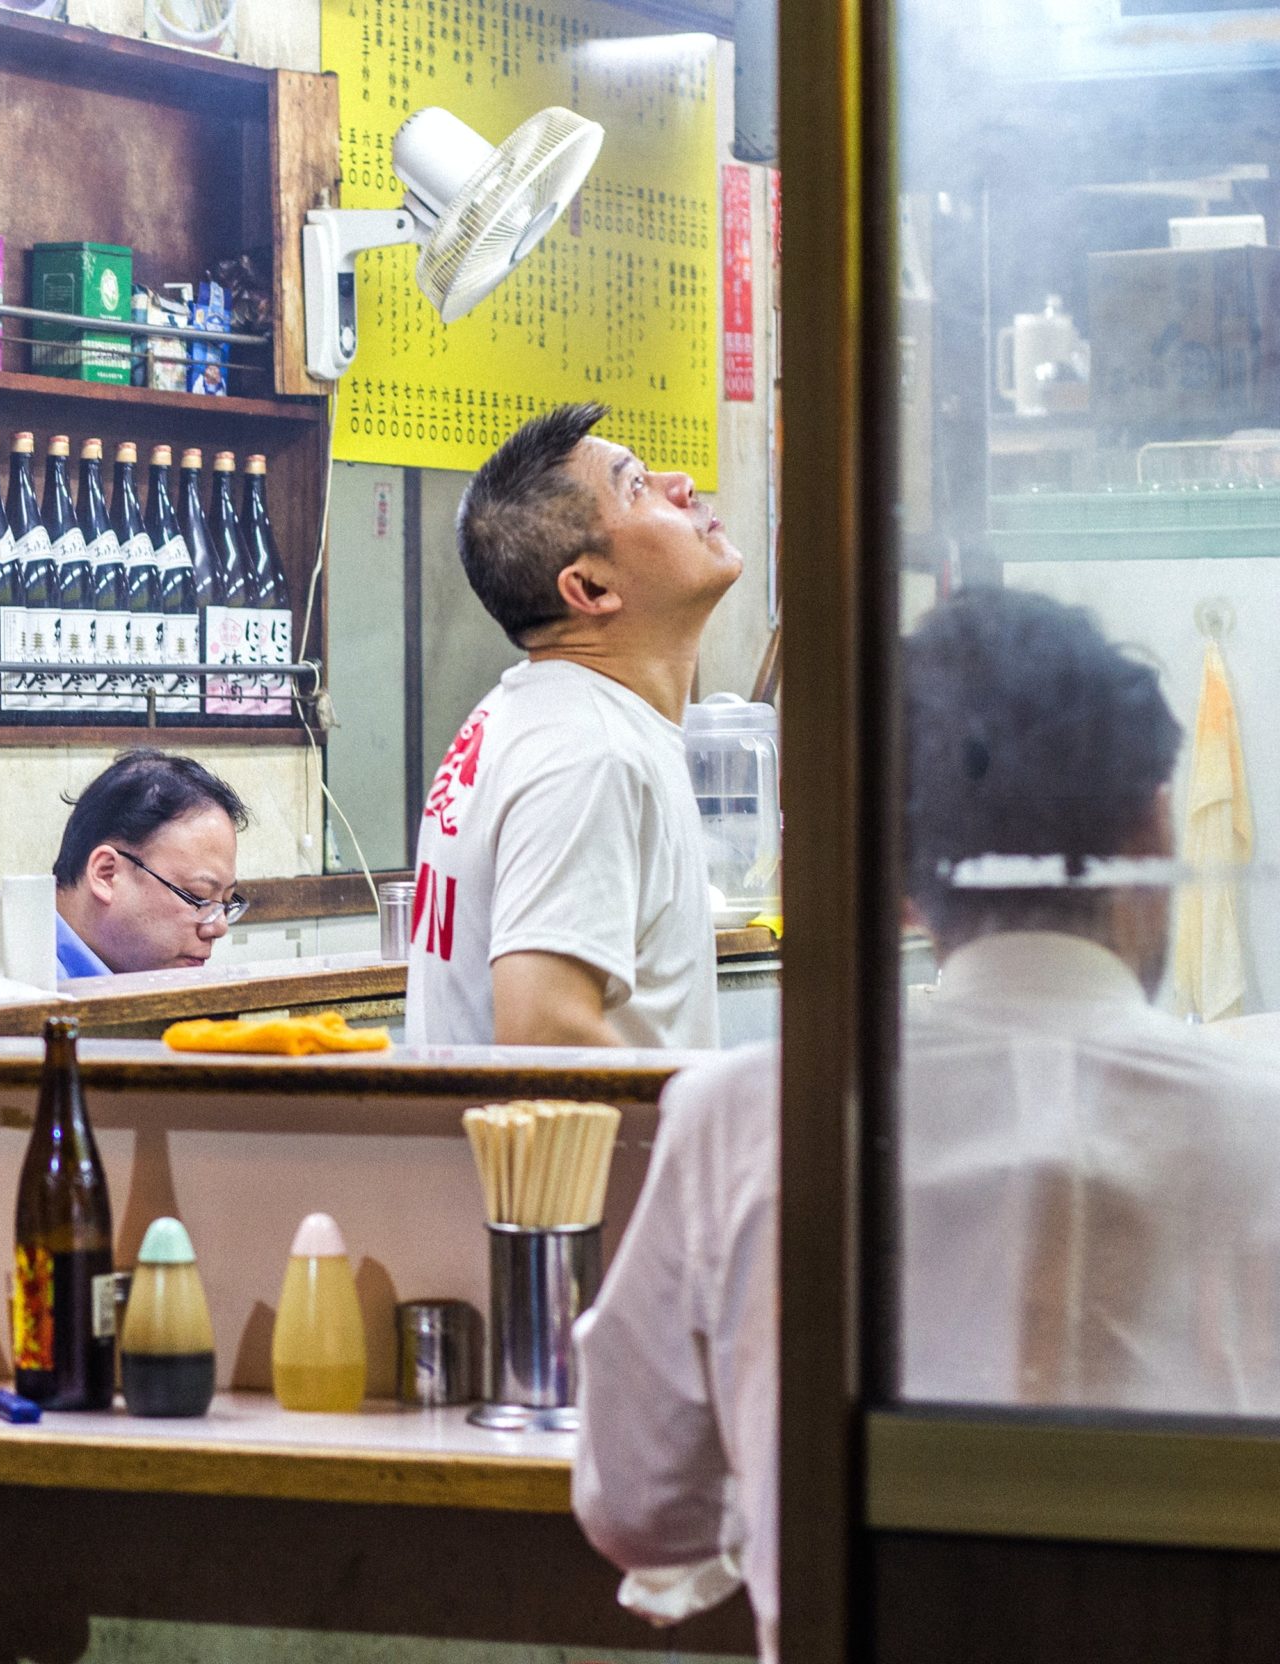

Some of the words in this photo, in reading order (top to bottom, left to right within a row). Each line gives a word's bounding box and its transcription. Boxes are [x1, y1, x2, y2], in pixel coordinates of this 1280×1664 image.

[350, 376, 360, 434] 七二〇
[364, 377, 373, 435] 七八〇
[377, 378, 386, 436] 七二〇
[390, 379, 399, 438] 七八〇
[403, 381, 413, 439] 七二〇
